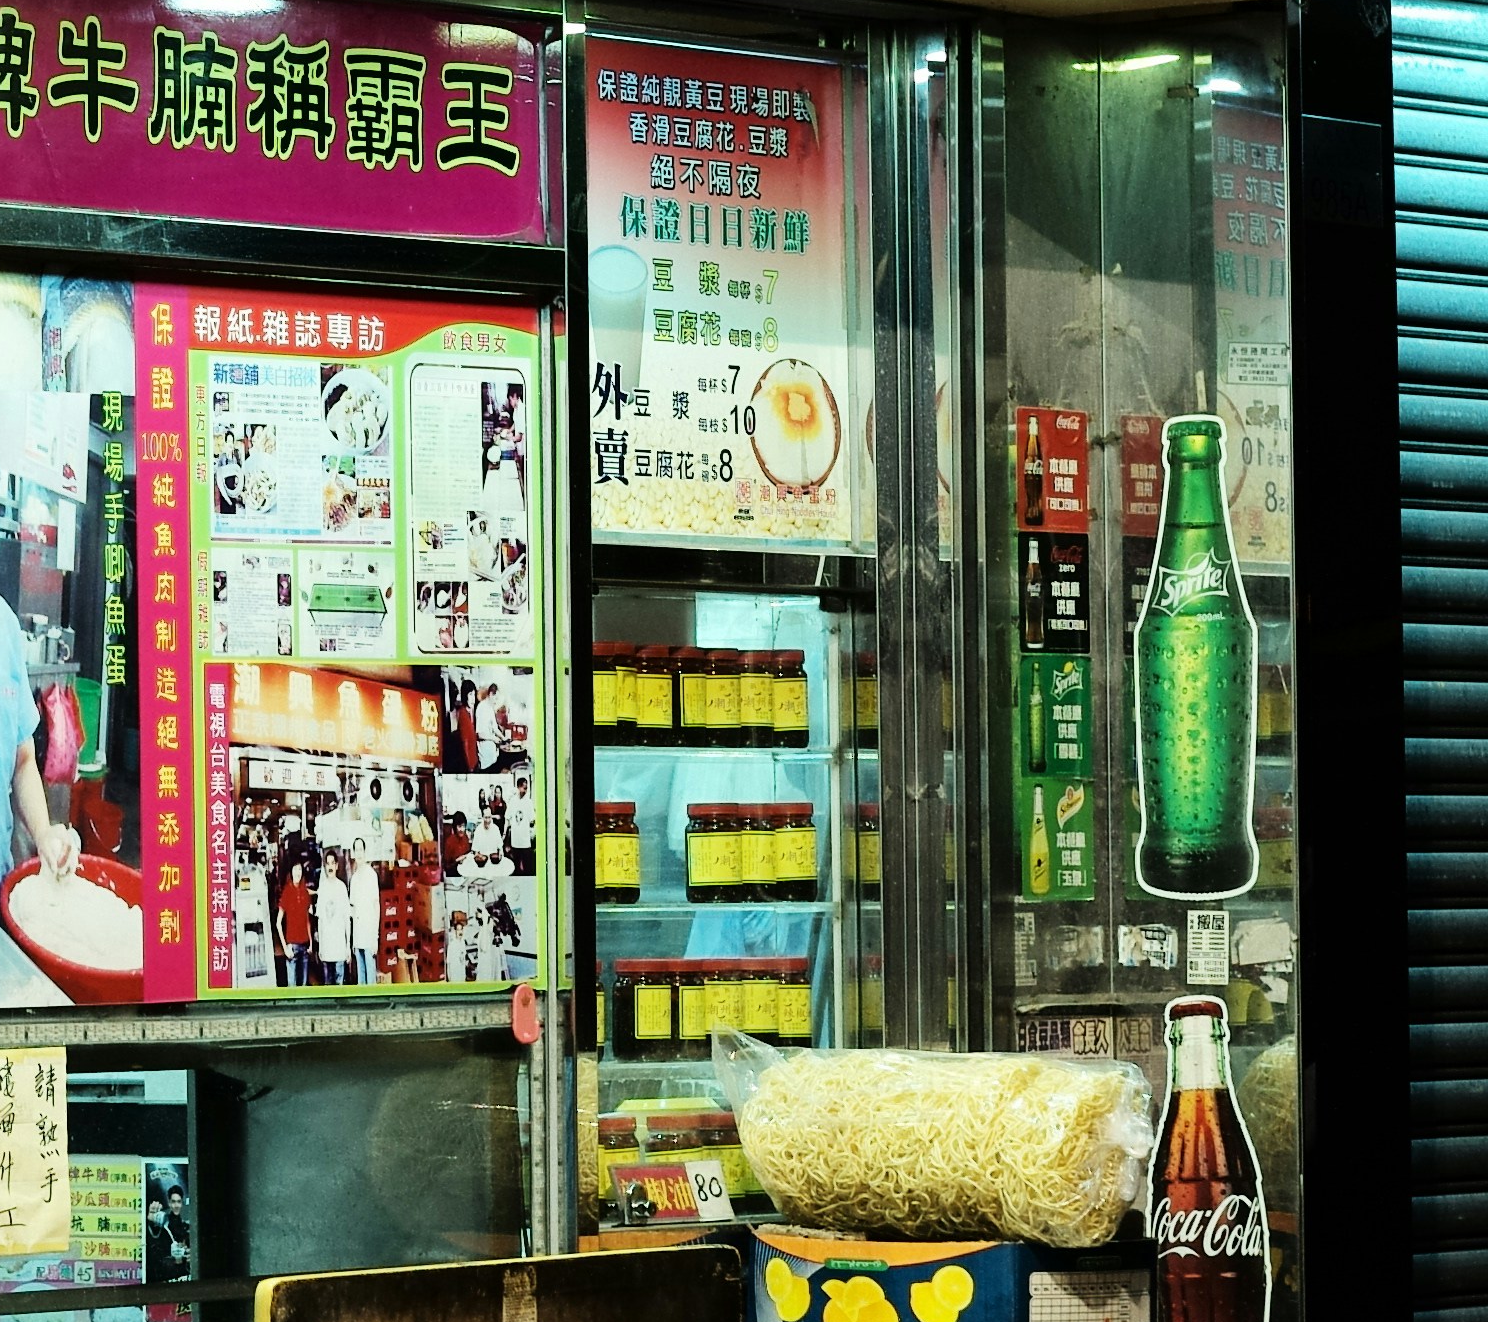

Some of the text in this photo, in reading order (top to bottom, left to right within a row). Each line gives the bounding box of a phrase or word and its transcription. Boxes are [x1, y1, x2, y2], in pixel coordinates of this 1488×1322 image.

[651, 156, 760, 198] 絕不隔夜
[620, 194, 811, 255] 保證日日新鮮
[194, 305, 385, 352] 報紙.雜誌專訪
[443, 331, 507, 352] 飲食男女
[653, 308, 721, 347] 豆腐花
[721, 365, 740, 394] $7
[592, 361, 629, 487] 外賣
[722, 406, 756, 435] $10
[634, 448, 733, 483] 豆腐花 $8
[102, 390, 126, 687] 現場手唧魚蛋
[1163, 567, 1222, 606] Sprite
[209, 684, 229, 972] 電視台美食名主持專訪
[694, 1173, 723, 1200] 80
[1153, 1194, 1263, 1260] Coca-Cola
